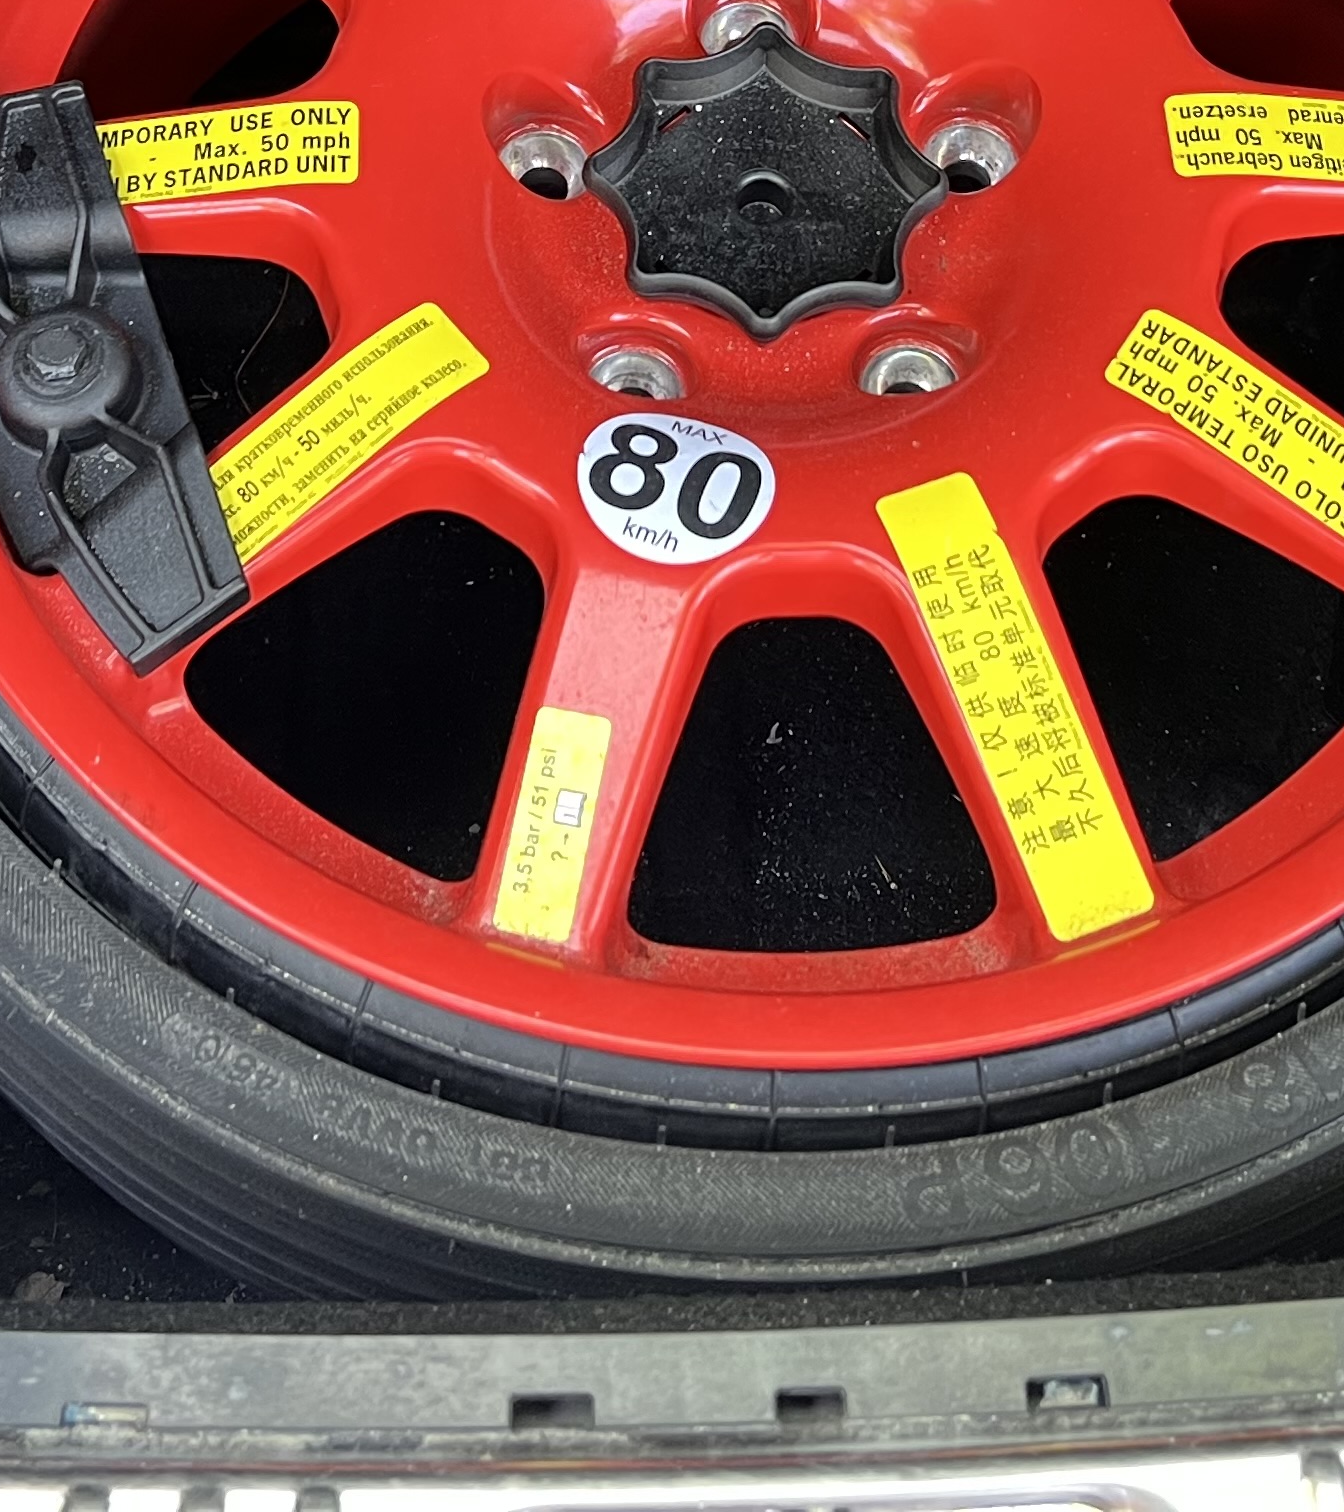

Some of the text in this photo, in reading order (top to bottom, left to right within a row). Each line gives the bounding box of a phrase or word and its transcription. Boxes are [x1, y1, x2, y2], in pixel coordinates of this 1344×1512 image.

[229, 102, 352, 134] USE ONLY
[1168, 98, 1269, 126] ersetzen.
[193, 137, 249, 163] Max.
[259, 131, 289, 154] 50
[301, 128, 351, 155] mph
[1173, 120, 1222, 149] mph
[1233, 126, 1263, 147] 50
[1274, 128, 1324, 151] Max.
[126, 171, 154, 194] BY
[163, 156, 289, 189] STANDARD
[295, 152, 352, 178] UNIT
[1178, 146, 1284, 174] Gebrauch.
[1125, 332, 1181, 381] mph
[1137, 312, 1265, 410] ESTÁNDAR
[232, 377, 349, 478] кратковременного
[340, 310, 435, 388] использования.
[1108, 353, 1239, 453] TEMPORAL
[1183, 371, 1219, 405] 50
[291, 441, 354, 499] заменить
[349, 427, 369, 448] на
[362, 378, 425, 435] серийное
[419, 351, 469, 395] колесо.
[671, 420, 728, 446] MAX
[1223, 398, 1284, 449] Máx.
[235, 475, 261, 508] 80
[256, 447, 297, 493] км/ч
[295, 425, 322, 455] 50
[315, 383, 376, 442] миль/ч.
[1237, 439, 1291, 487] USO
[588, 424, 762, 540] 80
[622, 516, 679, 553] km/h
[936, 550, 984, 615] km/h
[969, 626, 1004, 664] 80
[535, 746, 560, 779] psi
[529, 783, 550, 807] 51
[518, 822, 542, 858] bar
